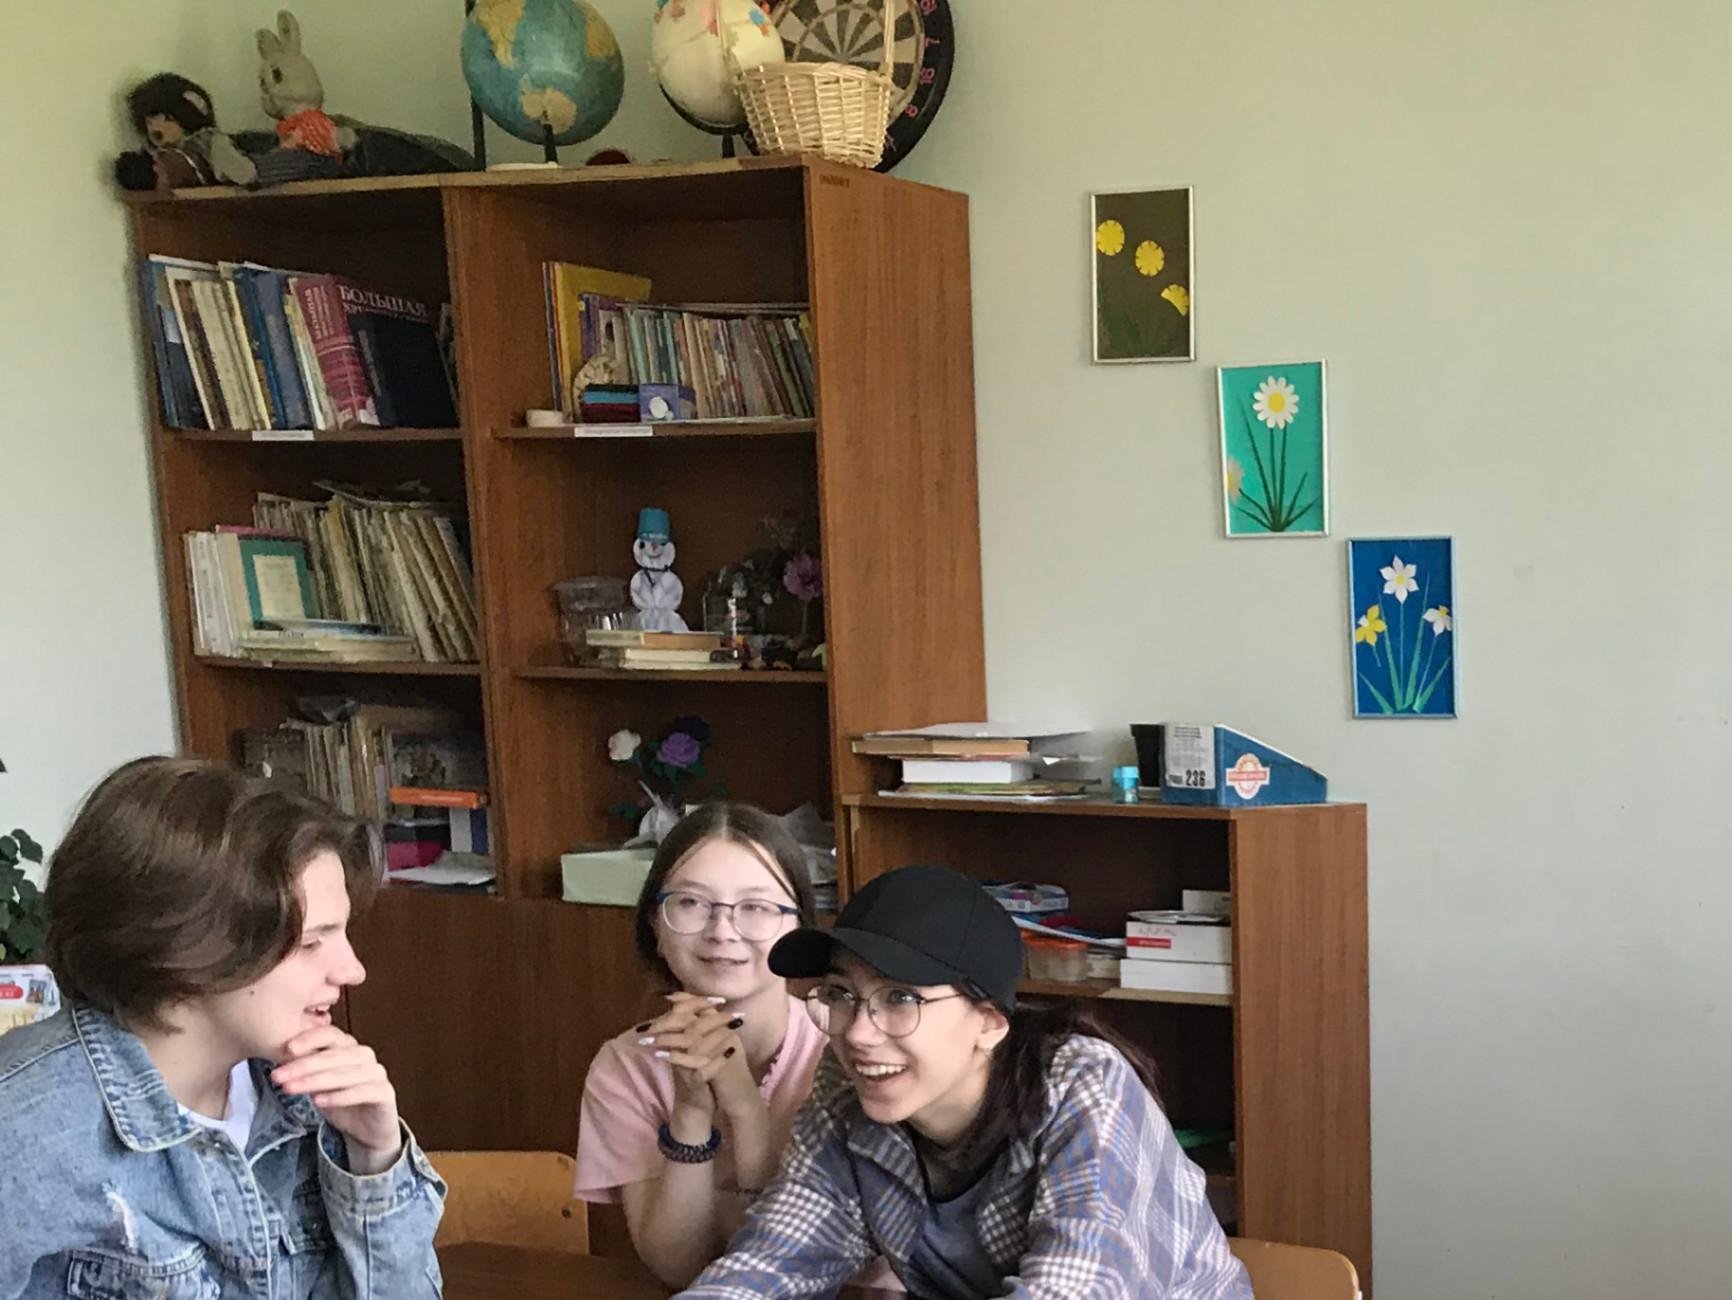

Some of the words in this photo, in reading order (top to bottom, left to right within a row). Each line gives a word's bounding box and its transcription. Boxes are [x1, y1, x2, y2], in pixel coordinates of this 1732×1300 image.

[905, 104, 918, 117] 8
[337, 285, 429, 318] БОЛЬШАЯ
[1185, 769, 1207, 788] 236
